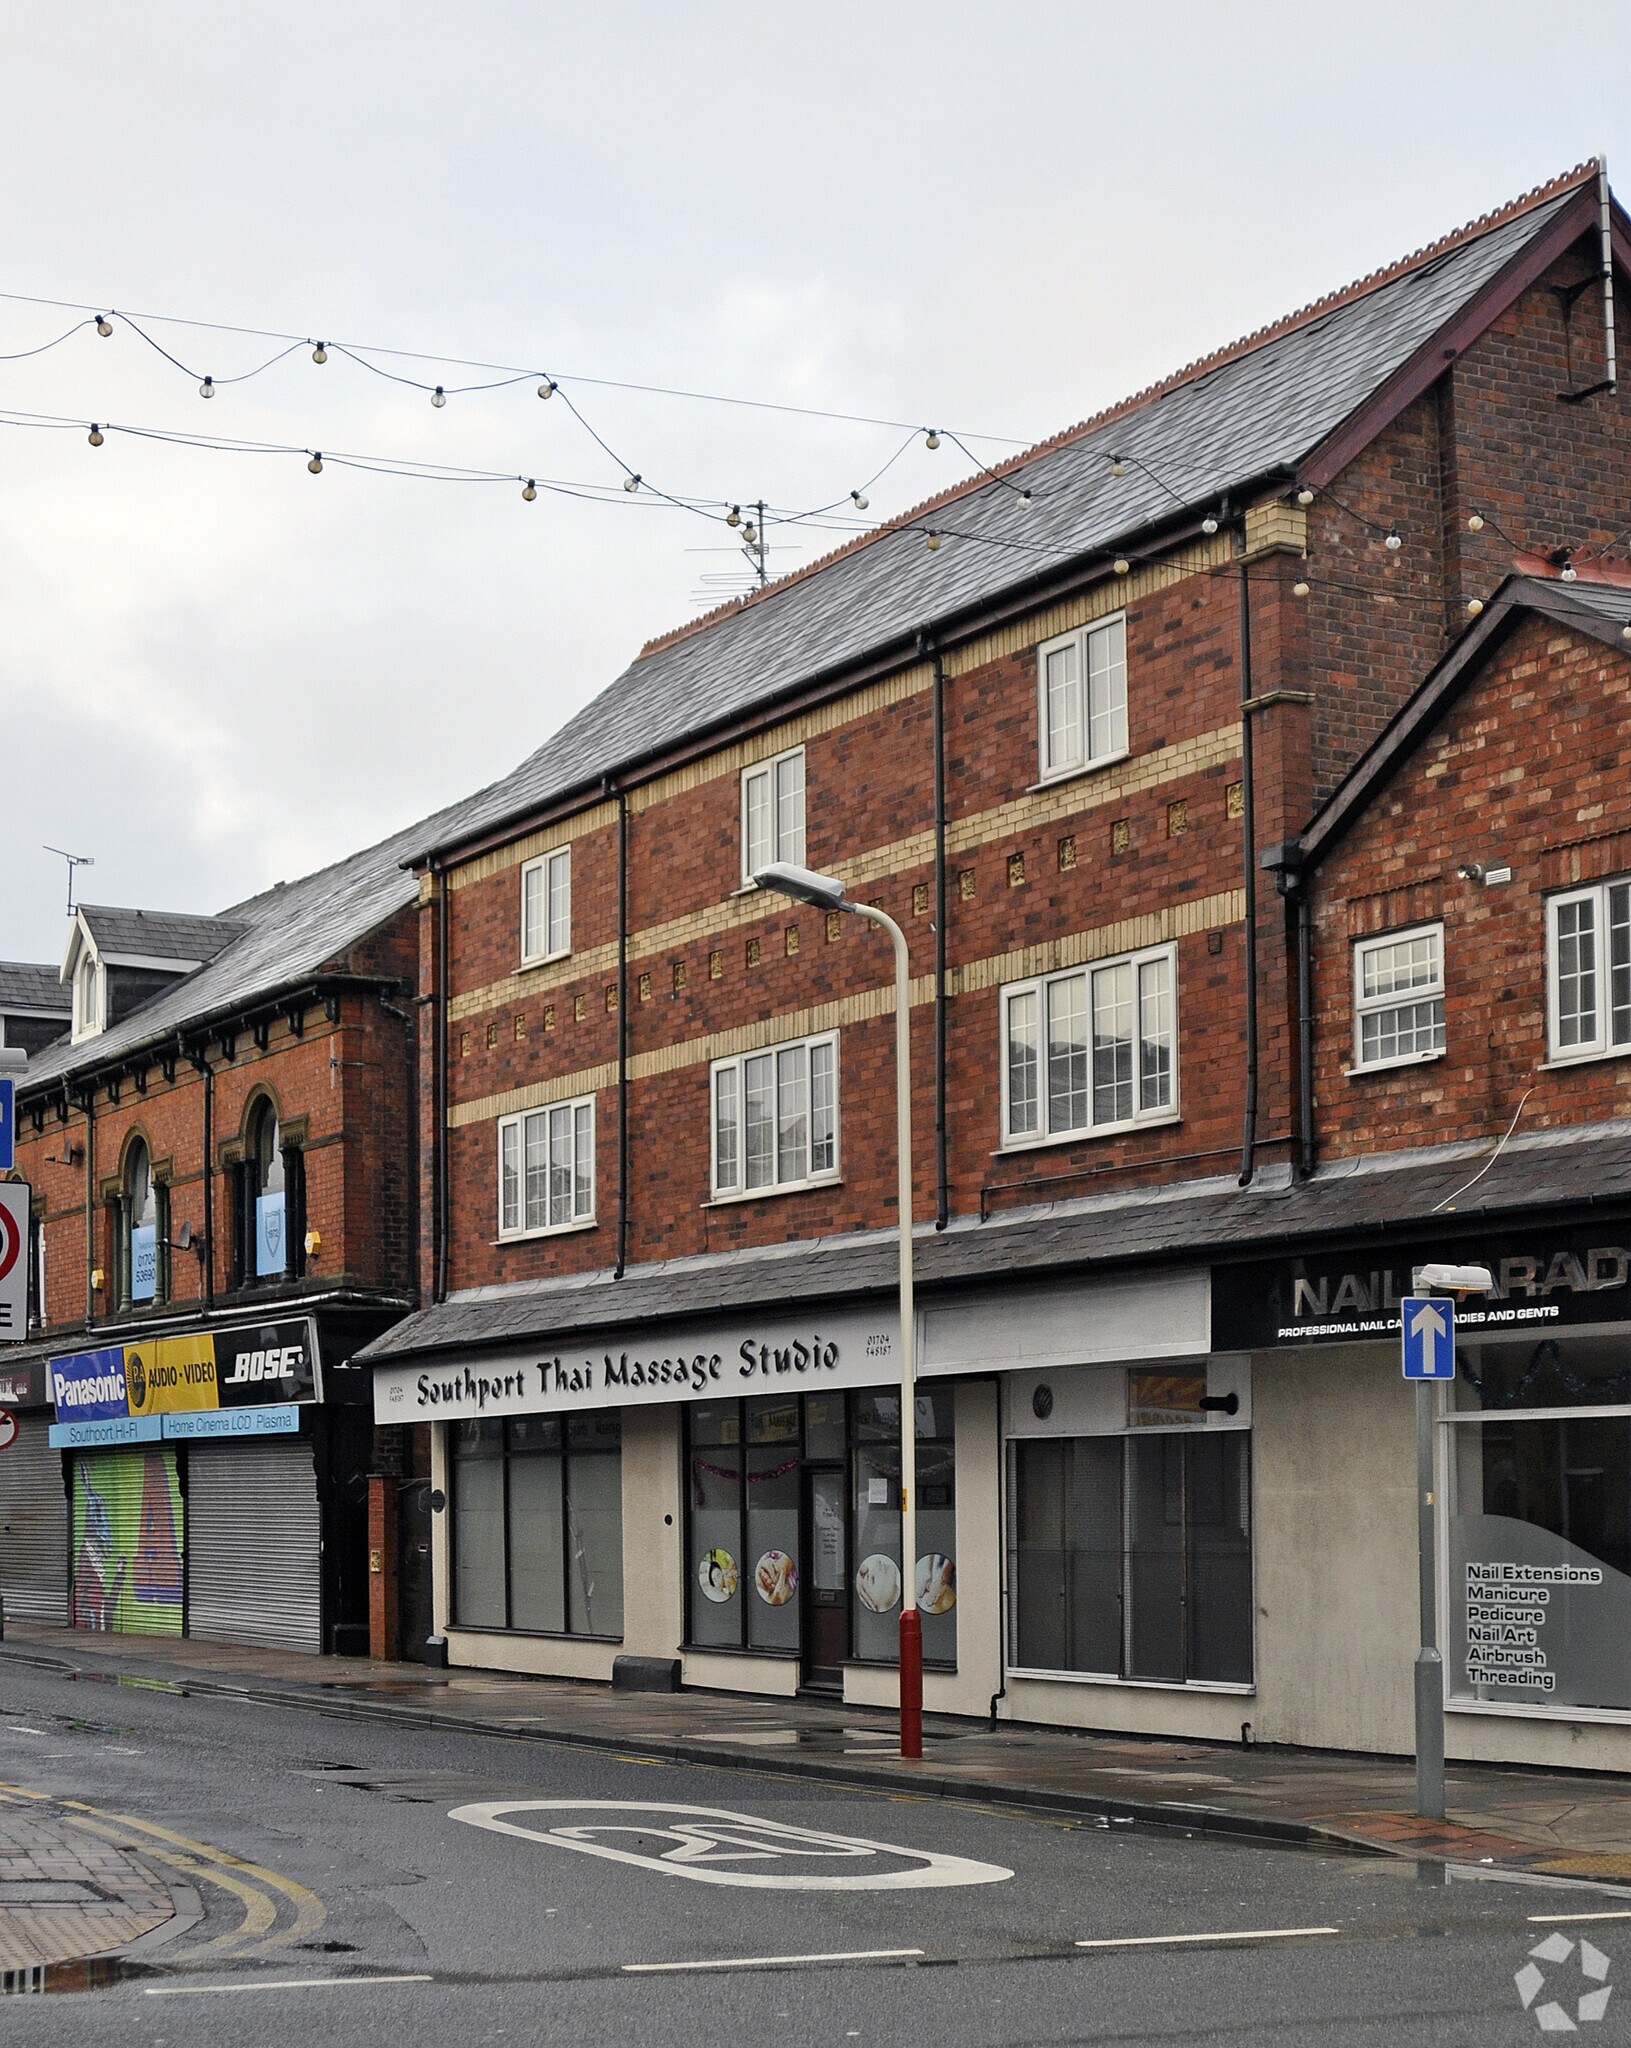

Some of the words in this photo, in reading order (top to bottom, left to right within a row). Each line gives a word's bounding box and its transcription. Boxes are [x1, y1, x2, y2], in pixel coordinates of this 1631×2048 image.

[1294, 1270, 1402, 1317] NAIL
[1456, 1246, 1629, 1303] ARAD
[1277, 1322, 1360, 1338] PROFESSIONAL
[1360, 1320, 1386, 1332] NAIL
[1386, 1318, 1403, 1330] CA
[1453, 1312, 1486, 1325] ADIES
[1487, 1310, 1516, 1322] AND
[1516, 1305, 1560, 1320] GENTS
[867, 1334, 890, 1346] 01704
[148, 1366, 177, 1388] AUDIO
[183, 1361, 215, 1385] VIDEO
[225, 1346, 303, 1384] BOSE
[417, 1366, 525, 1410] Southport
[536, 1356, 593, 1394] Thai
[603, 1351, 723, 1391] Massage
[738, 1334, 840, 1378] Studio
[53, 1365, 126, 1408] Panasonic
[168, 1419, 194, 1434] Home
[196, 1417, 230, 1433] Cinema
[231, 1414, 252, 1430] LCD
[256, 1413, 292, 1430] Plasma
[69, 1424, 113, 1445] Southport
[1467, 1565, 1499, 1580] Nail
[1503, 1566, 1601, 1581] Extensions
[1467, 1586, 1548, 1601] Manicure
[1468, 1606, 1544, 1622] Pedicure
[1468, 1627, 1500, 1641] Nail
[1504, 1628, 1535, 1643] Art
[1468, 1647, 1545, 1664] Airbrush
[1468, 1668, 1554, 1690] Threading
